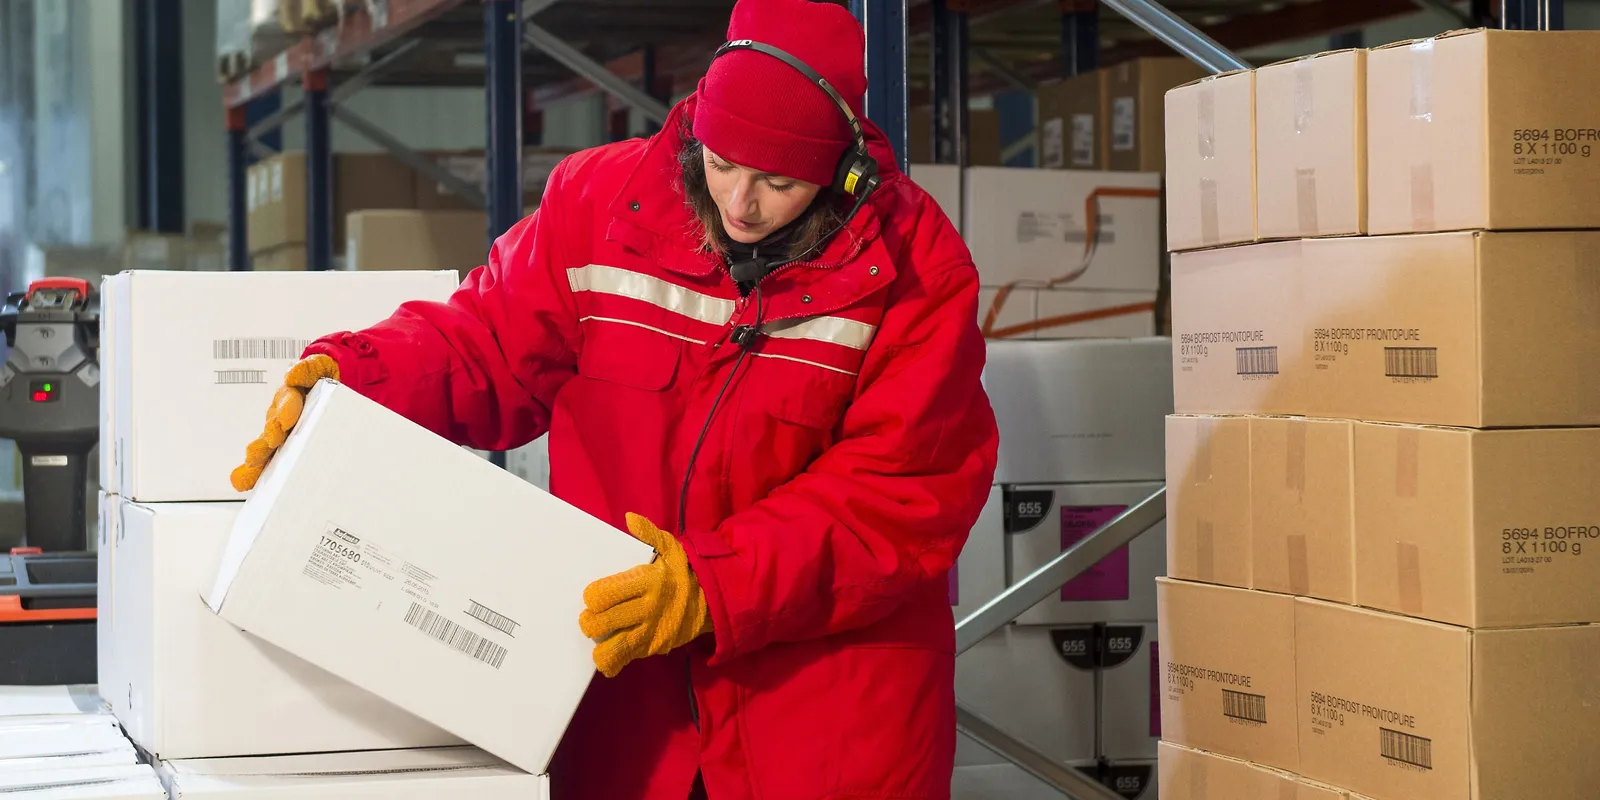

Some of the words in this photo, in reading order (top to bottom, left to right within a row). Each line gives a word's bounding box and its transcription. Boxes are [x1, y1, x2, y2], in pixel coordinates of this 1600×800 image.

[1513, 129, 1549, 141] 5694
[1554, 128, 1600, 141] BOFR
[1513, 142, 1522, 155] 8
[1527, 142, 1537, 155] X
[1542, 142, 1577, 155] 1100
[1581, 144, 1591, 157] g
[1181, 333, 1194, 344] 5694
[1194, 332, 1221, 344] BOFROST
[1221, 330, 1264, 343] PRONTOPURE
[1314, 328, 1330, 340] 5694
[1331, 328, 1365, 340] BOFROST
[1366, 328, 1420, 341] PRONTOPURE
[1181, 344, 1185, 355] 8
[1190, 344, 1203, 355] 1100
[1204, 346, 1208, 357] g
[1314, 340, 1319, 352] 8
[1320, 340, 1325, 352] X
[1326, 341, 1342, 353] 1100
[1343, 343, 1348, 356] g
[1018, 502, 1042, 514] 655
[1502, 528, 1539, 540] 5694
[1544, 525, 1600, 540] BOFRO
[320, 535, 361, 563] 1705680
[1502, 541, 1512, 554] 8
[1516, 541, 1527, 554] X
[1531, 540, 1567, 553] 1100
[1571, 542, 1582, 556] g
[1062, 640, 1086, 652] 655
[1109, 637, 1132, 650] 655
[1167, 662, 1179, 674] 5694
[1180, 664, 1207, 680] BOFROST
[1207, 670, 1252, 688] PRONTOPURE
[1176, 675, 1189, 688] 1100
[1189, 680, 1194, 692] g
[1311, 691, 1326, 705] 5694
[1327, 695, 1360, 714] BOFROST
[1362, 704, 1415, 729] PRONTOPURE
[1311, 703, 1316, 715] 8
[1316, 704, 1322, 717] X
[1322, 707, 1338, 721] 1100
[1339, 713, 1344, 726] g
[1116, 776, 1140, 789] 655
